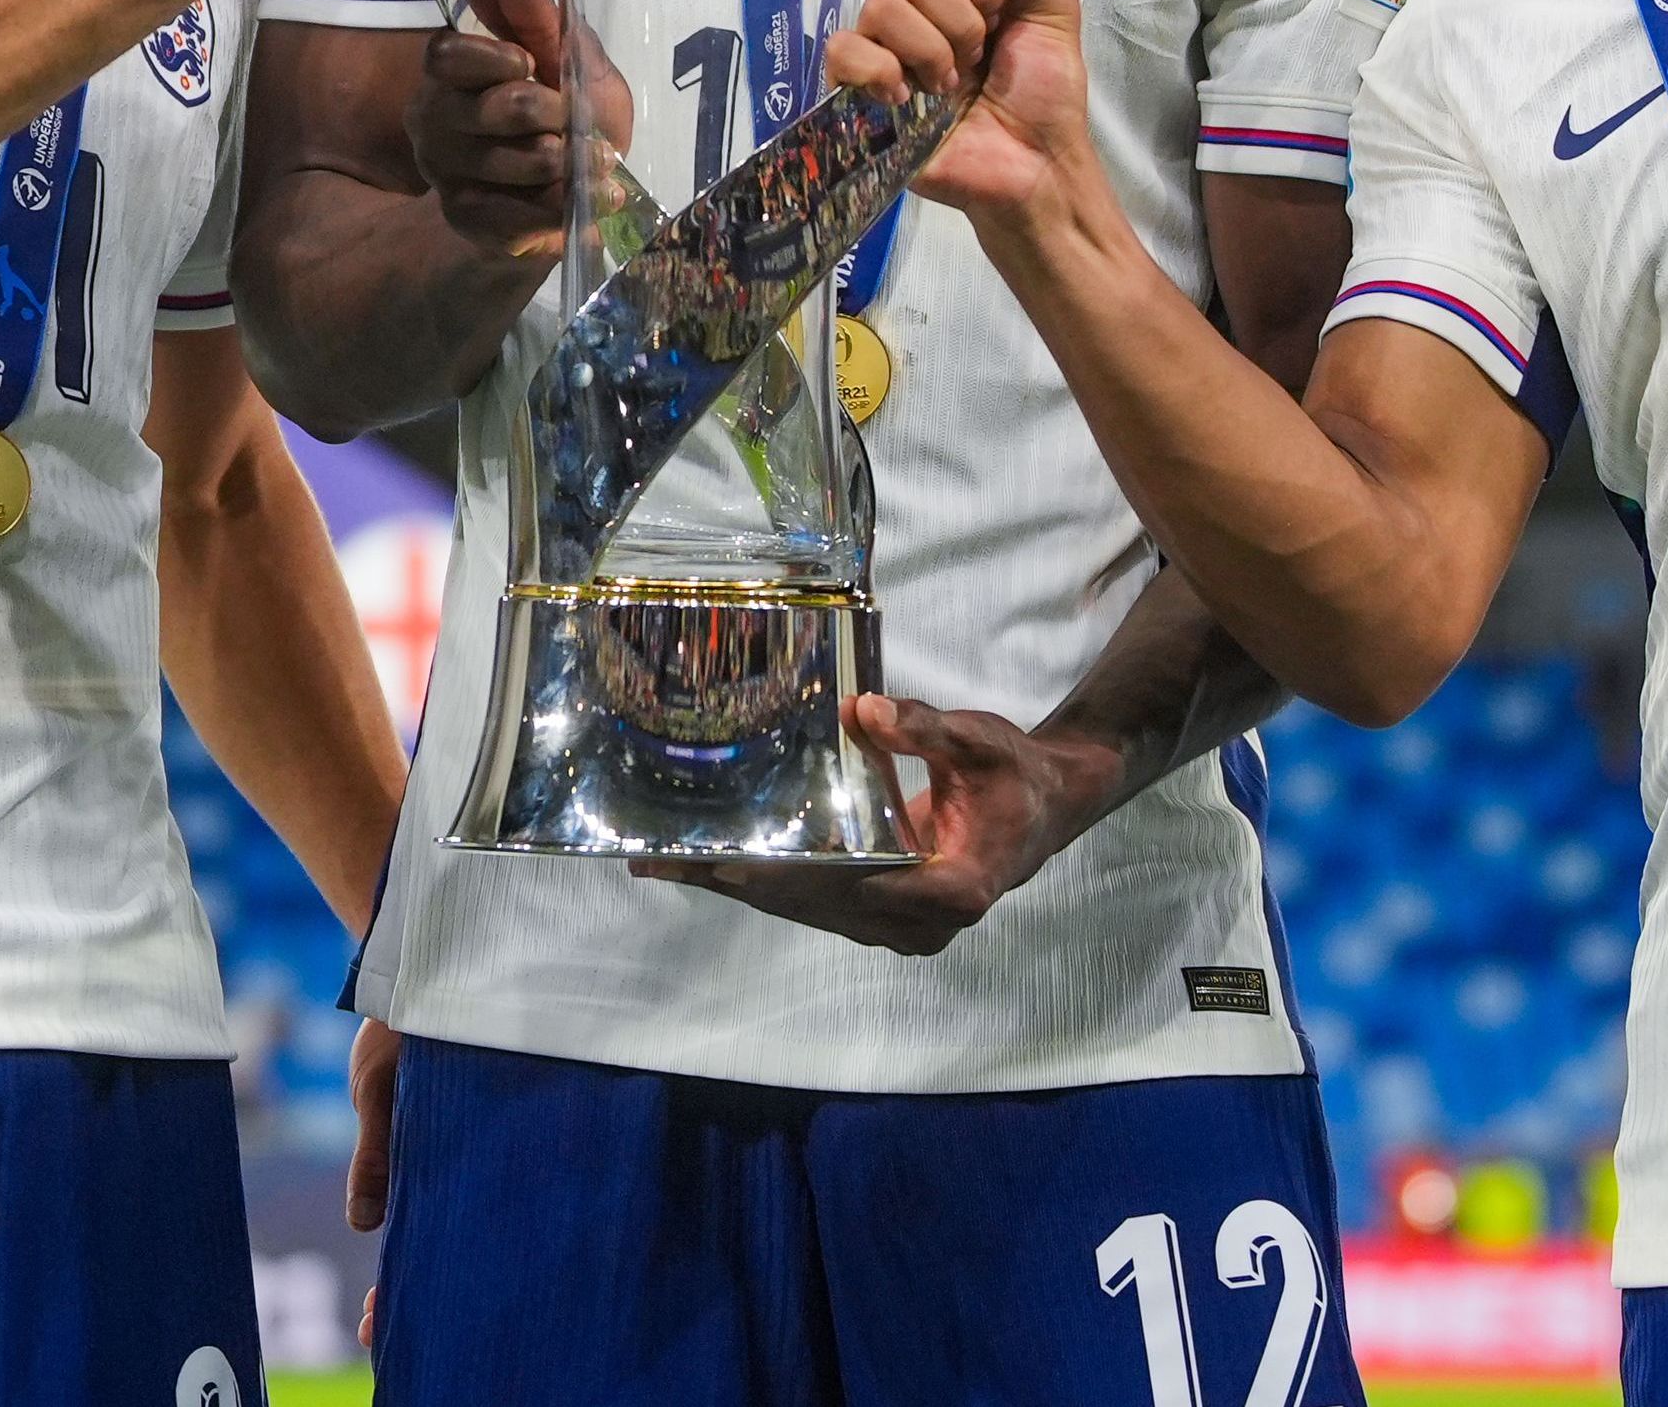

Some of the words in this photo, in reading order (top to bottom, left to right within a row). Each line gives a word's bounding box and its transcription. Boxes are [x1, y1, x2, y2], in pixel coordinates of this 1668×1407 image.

[772, 12, 783, 75] UNDER21
[45, 107, 63, 169] CHAMPIONSHIP
[1095, 1198, 1329, 1407] 12
